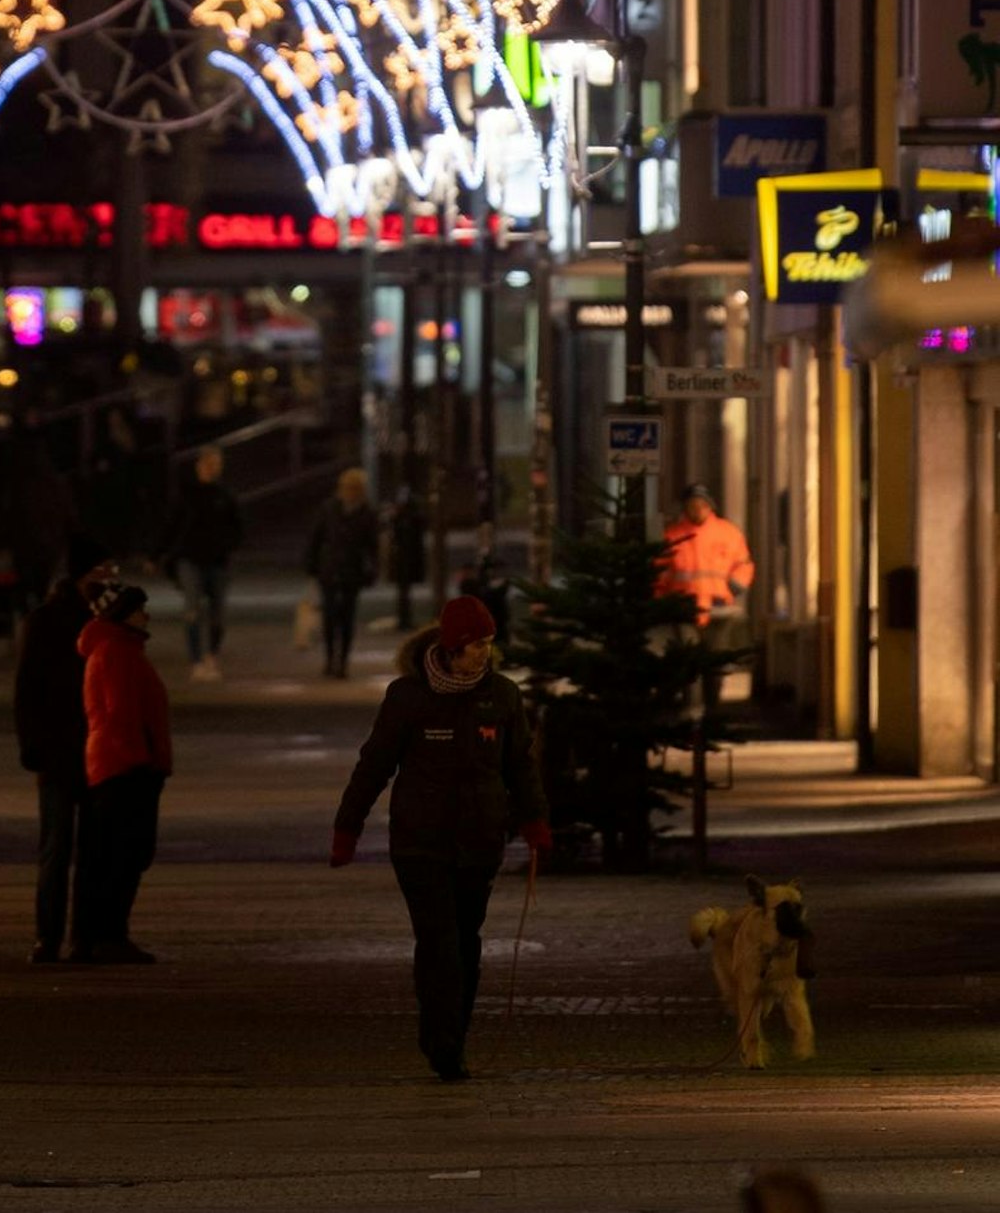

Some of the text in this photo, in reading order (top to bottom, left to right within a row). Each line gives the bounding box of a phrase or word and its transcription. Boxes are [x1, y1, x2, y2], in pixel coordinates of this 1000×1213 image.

[201, 213, 300, 249] GRILL
[666, 372, 727, 392] Berliner
[611, 427, 637, 442] WC
